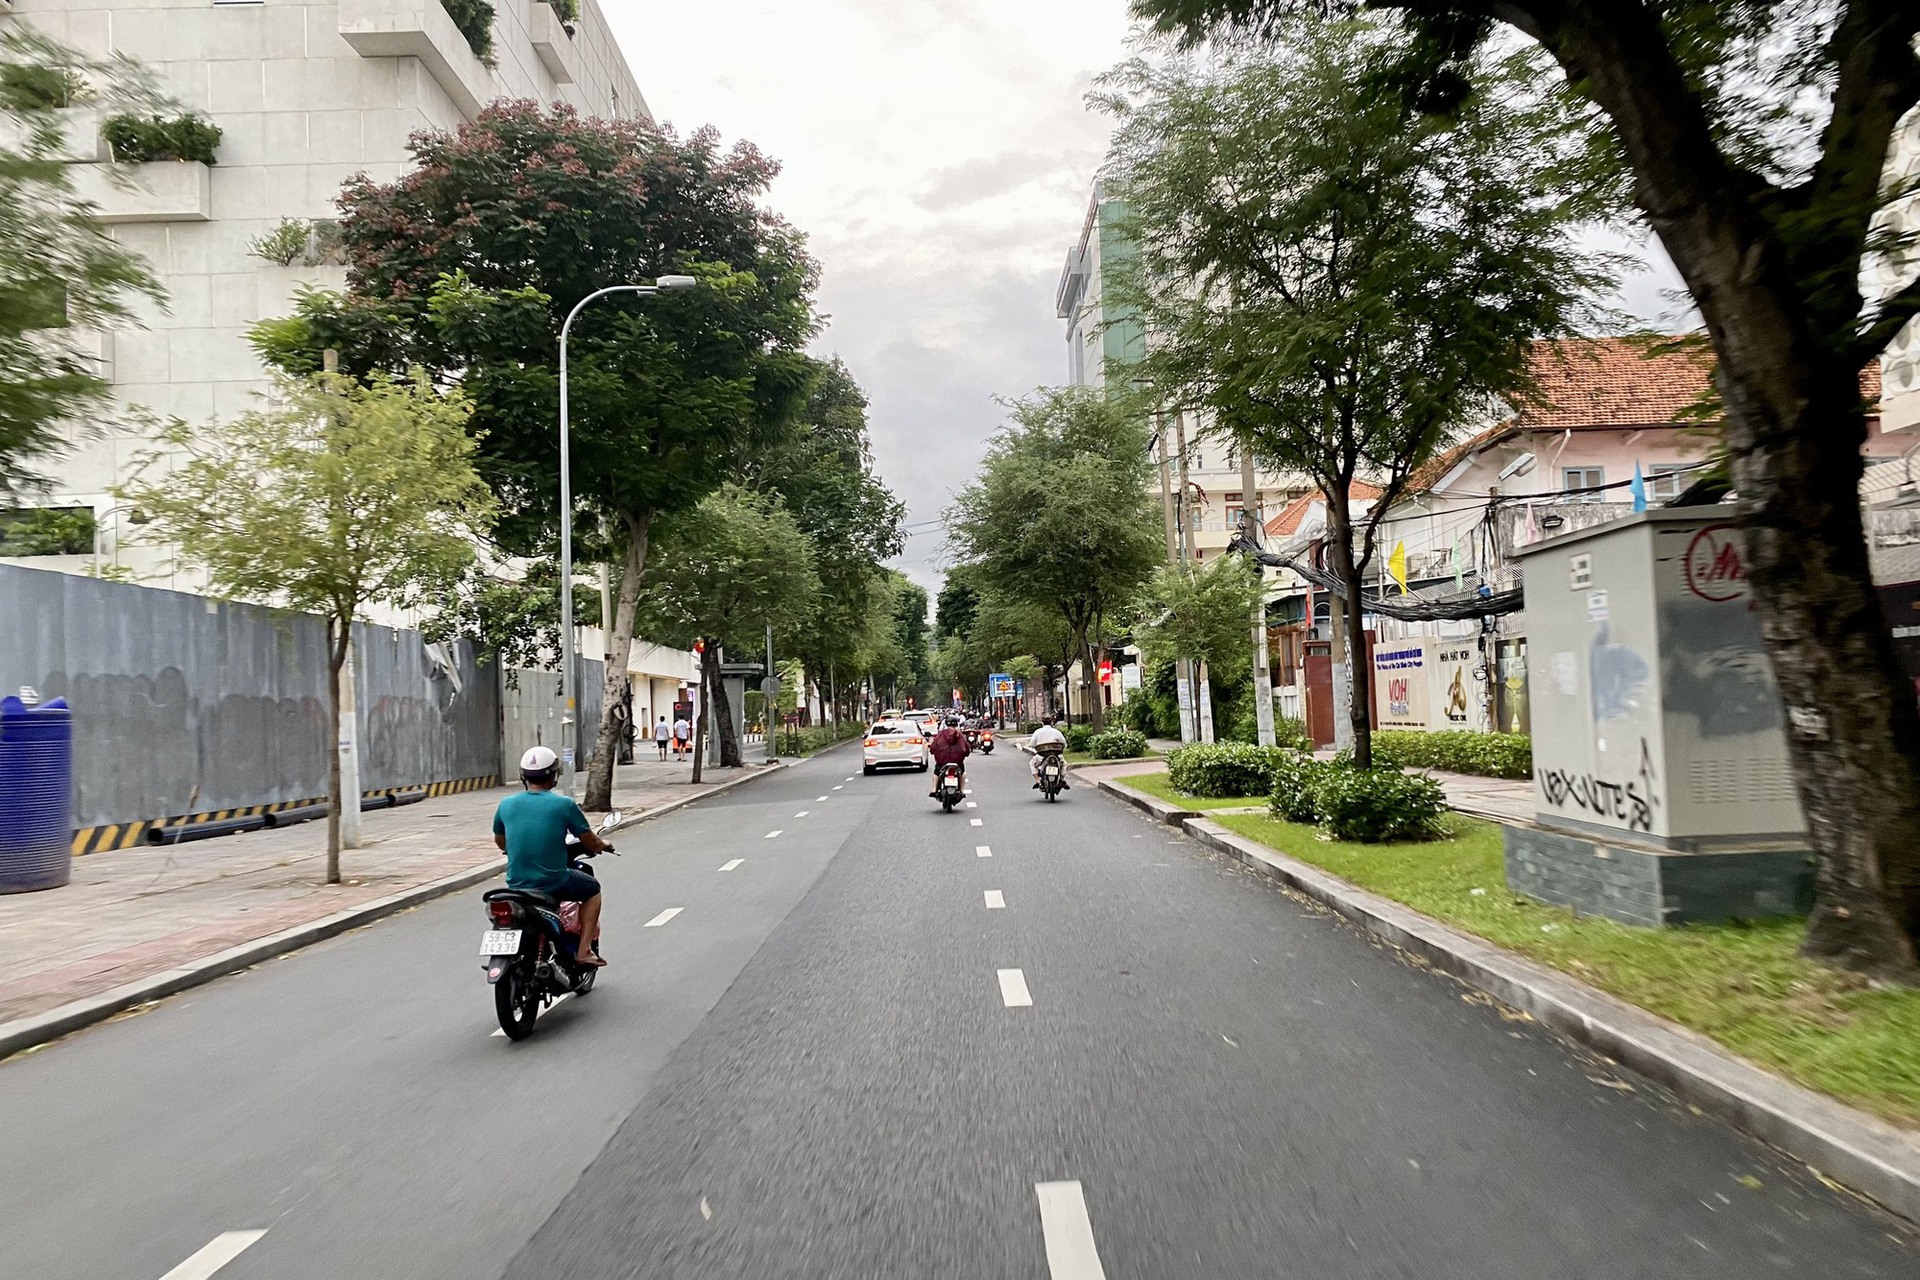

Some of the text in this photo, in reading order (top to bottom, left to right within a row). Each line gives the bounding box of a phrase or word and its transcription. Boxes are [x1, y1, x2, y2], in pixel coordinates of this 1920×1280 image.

[1440, 649, 1470, 662] NHÀ HÁT VOH
[1389, 678, 1407, 701] VOH
